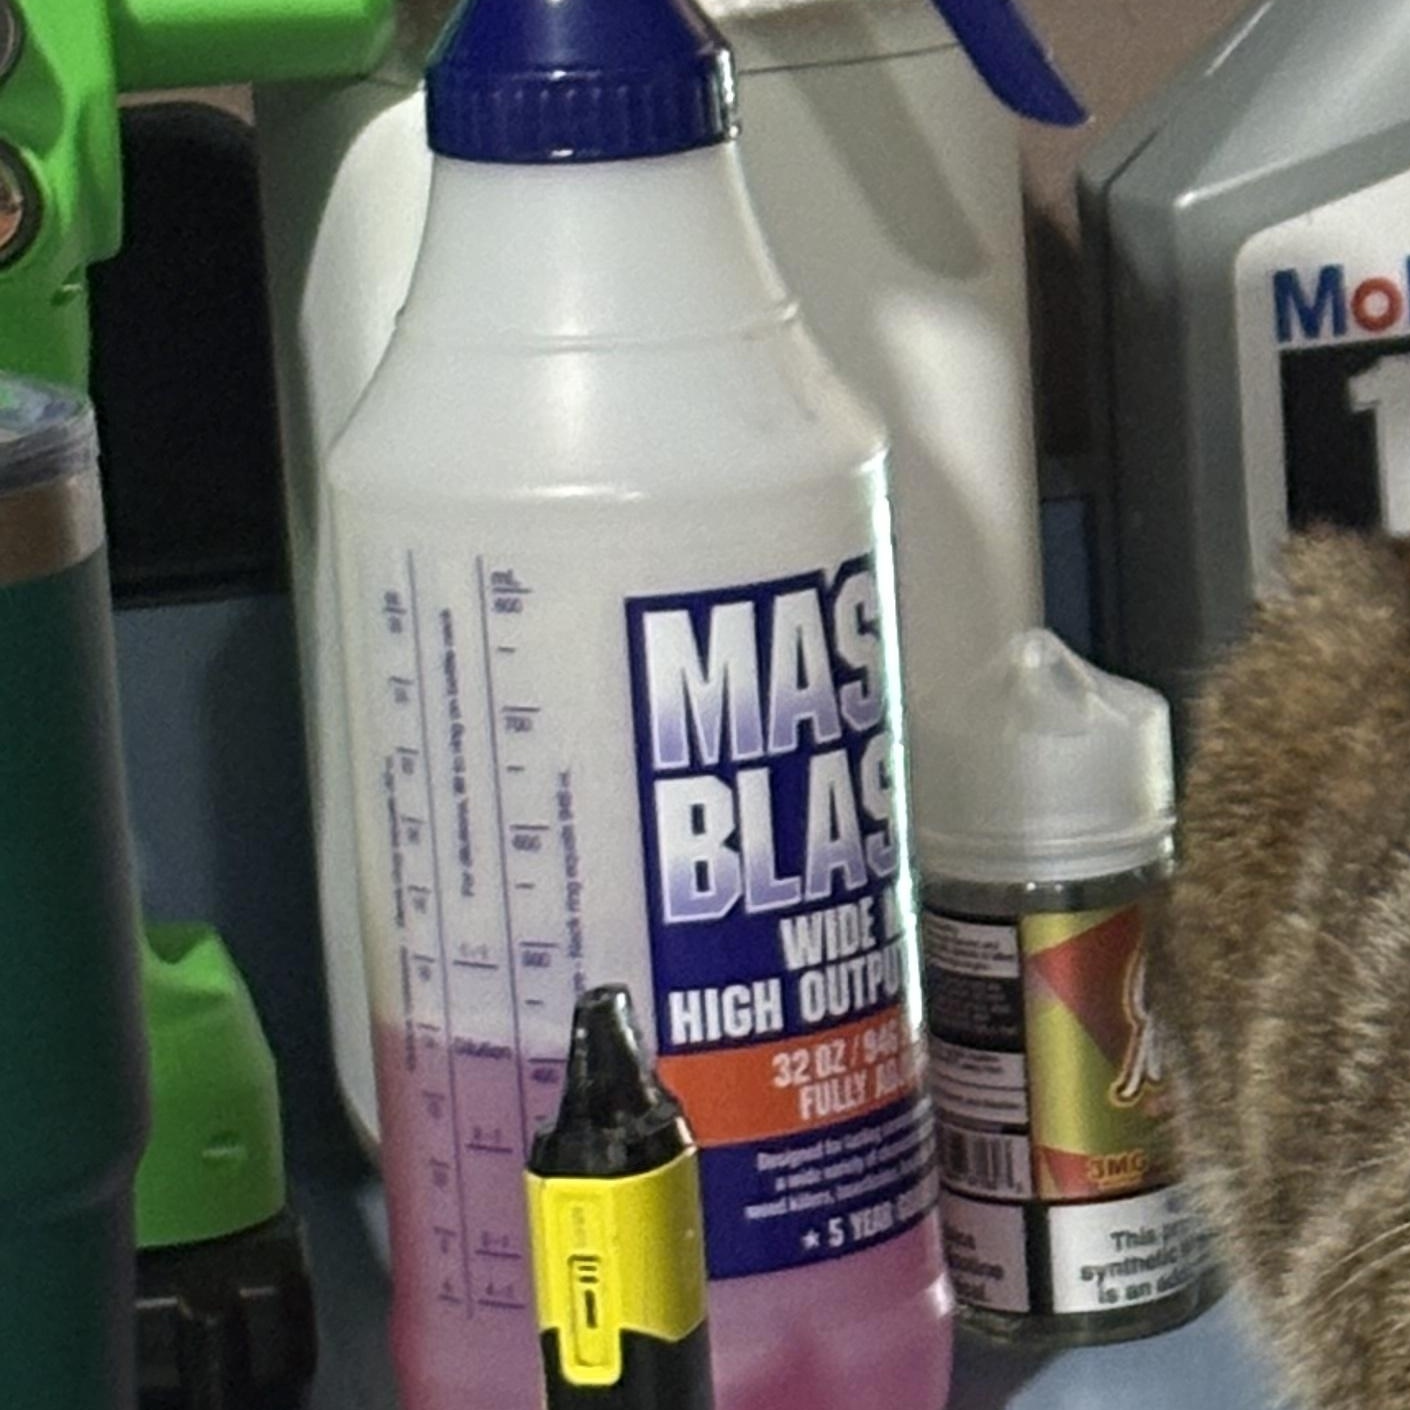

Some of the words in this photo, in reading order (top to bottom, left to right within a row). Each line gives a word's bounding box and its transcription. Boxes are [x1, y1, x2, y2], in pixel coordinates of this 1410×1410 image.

[779, 896, 876, 971] WIDE
[668, 978, 784, 1046] HIGH
[772, 1049, 811, 1088] 32
[815, 1038, 848, 1078] OZ
[799, 1069, 868, 1120] FULLY
[1089, 1151, 1144, 1181] 3MG
[827, 1216, 845, 1247] 5
[849, 1201, 893, 1241] YEAR
[1110, 1226, 1156, 1251] This
[1080, 1247, 1178, 1287] synthetic
[1098, 1287, 1118, 1304] is
[1126, 1282, 1152, 1301] an
